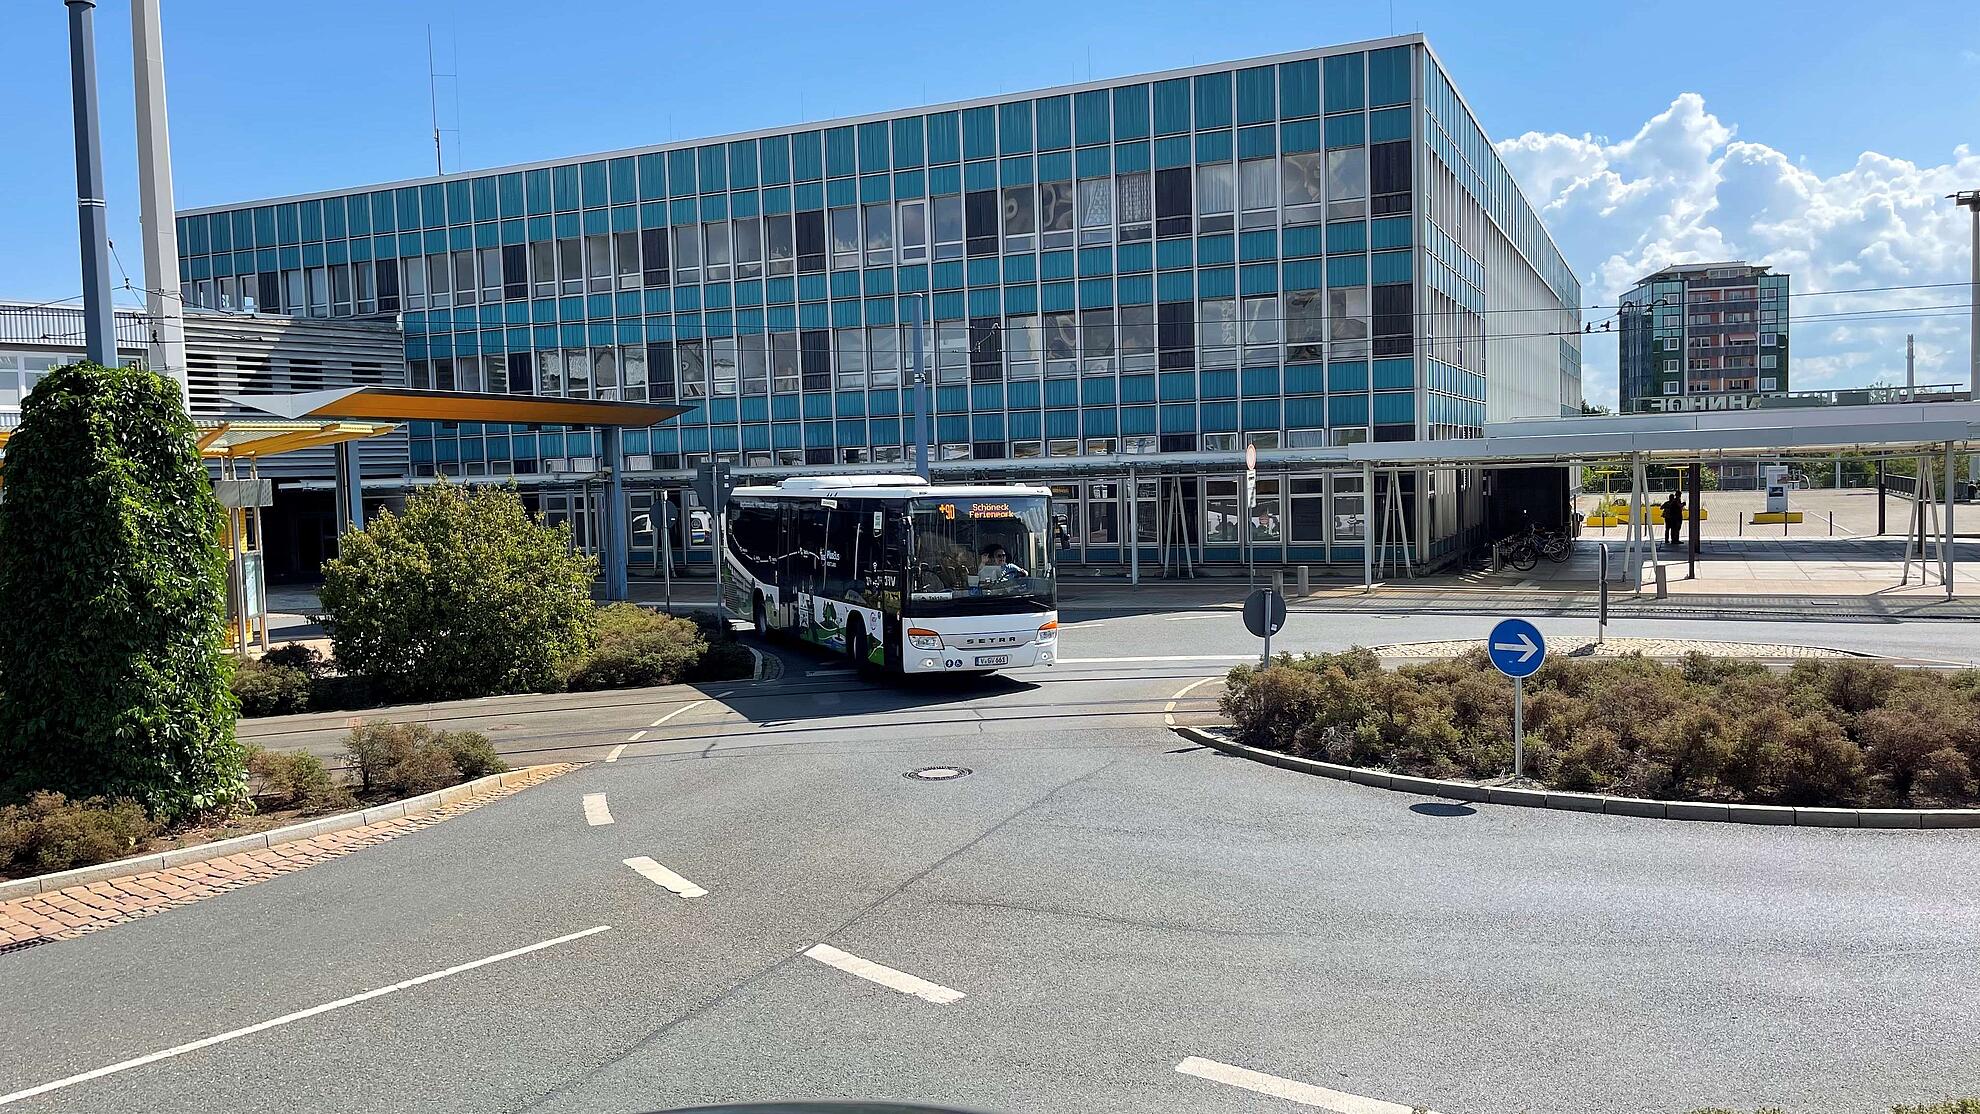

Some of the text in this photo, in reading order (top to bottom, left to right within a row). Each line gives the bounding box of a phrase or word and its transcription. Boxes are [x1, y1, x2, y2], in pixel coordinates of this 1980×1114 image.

[972, 503, 1009, 511] Schöneck
[969, 510, 1014, 519] Ferienpark
[1094, 568, 1101, 576] 2
[966, 636, 1016, 644] SETRA
